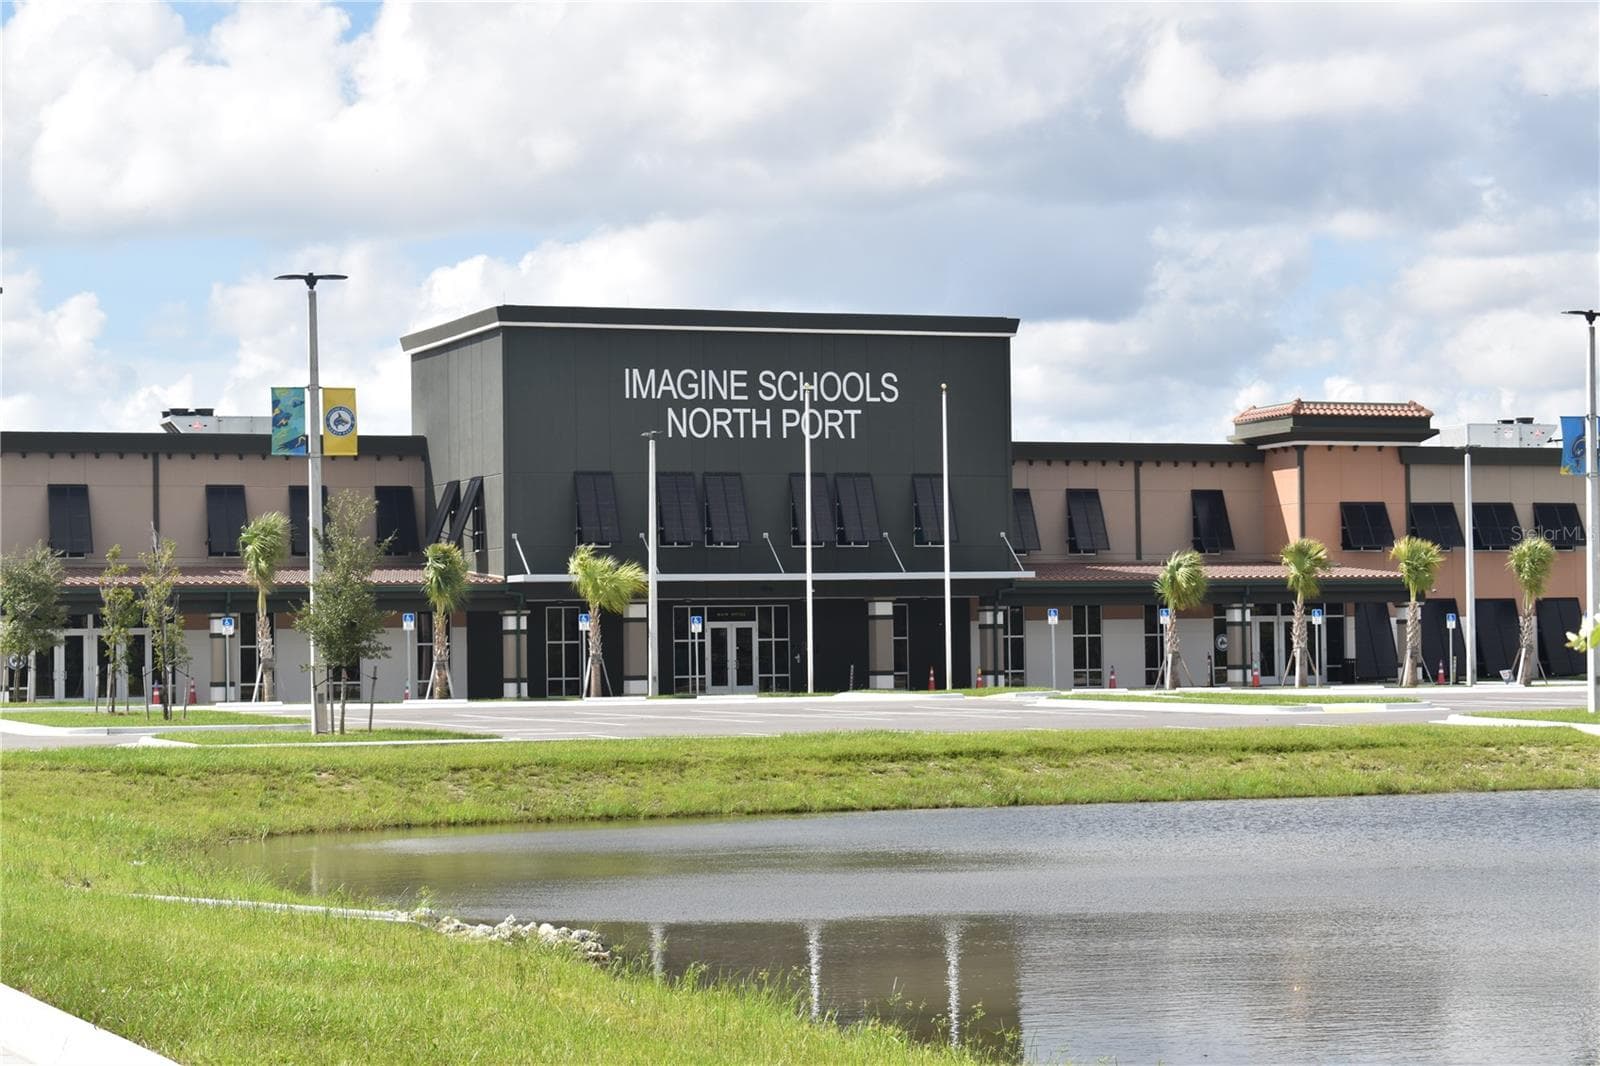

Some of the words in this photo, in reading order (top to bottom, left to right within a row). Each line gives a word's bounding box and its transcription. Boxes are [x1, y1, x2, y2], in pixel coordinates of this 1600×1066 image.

[624, 368, 749, 401] IMAGINE
[758, 370, 900, 403] SCHOOLS
[667, 407, 772, 439] NORTH
[782, 408, 862, 440] PORT
